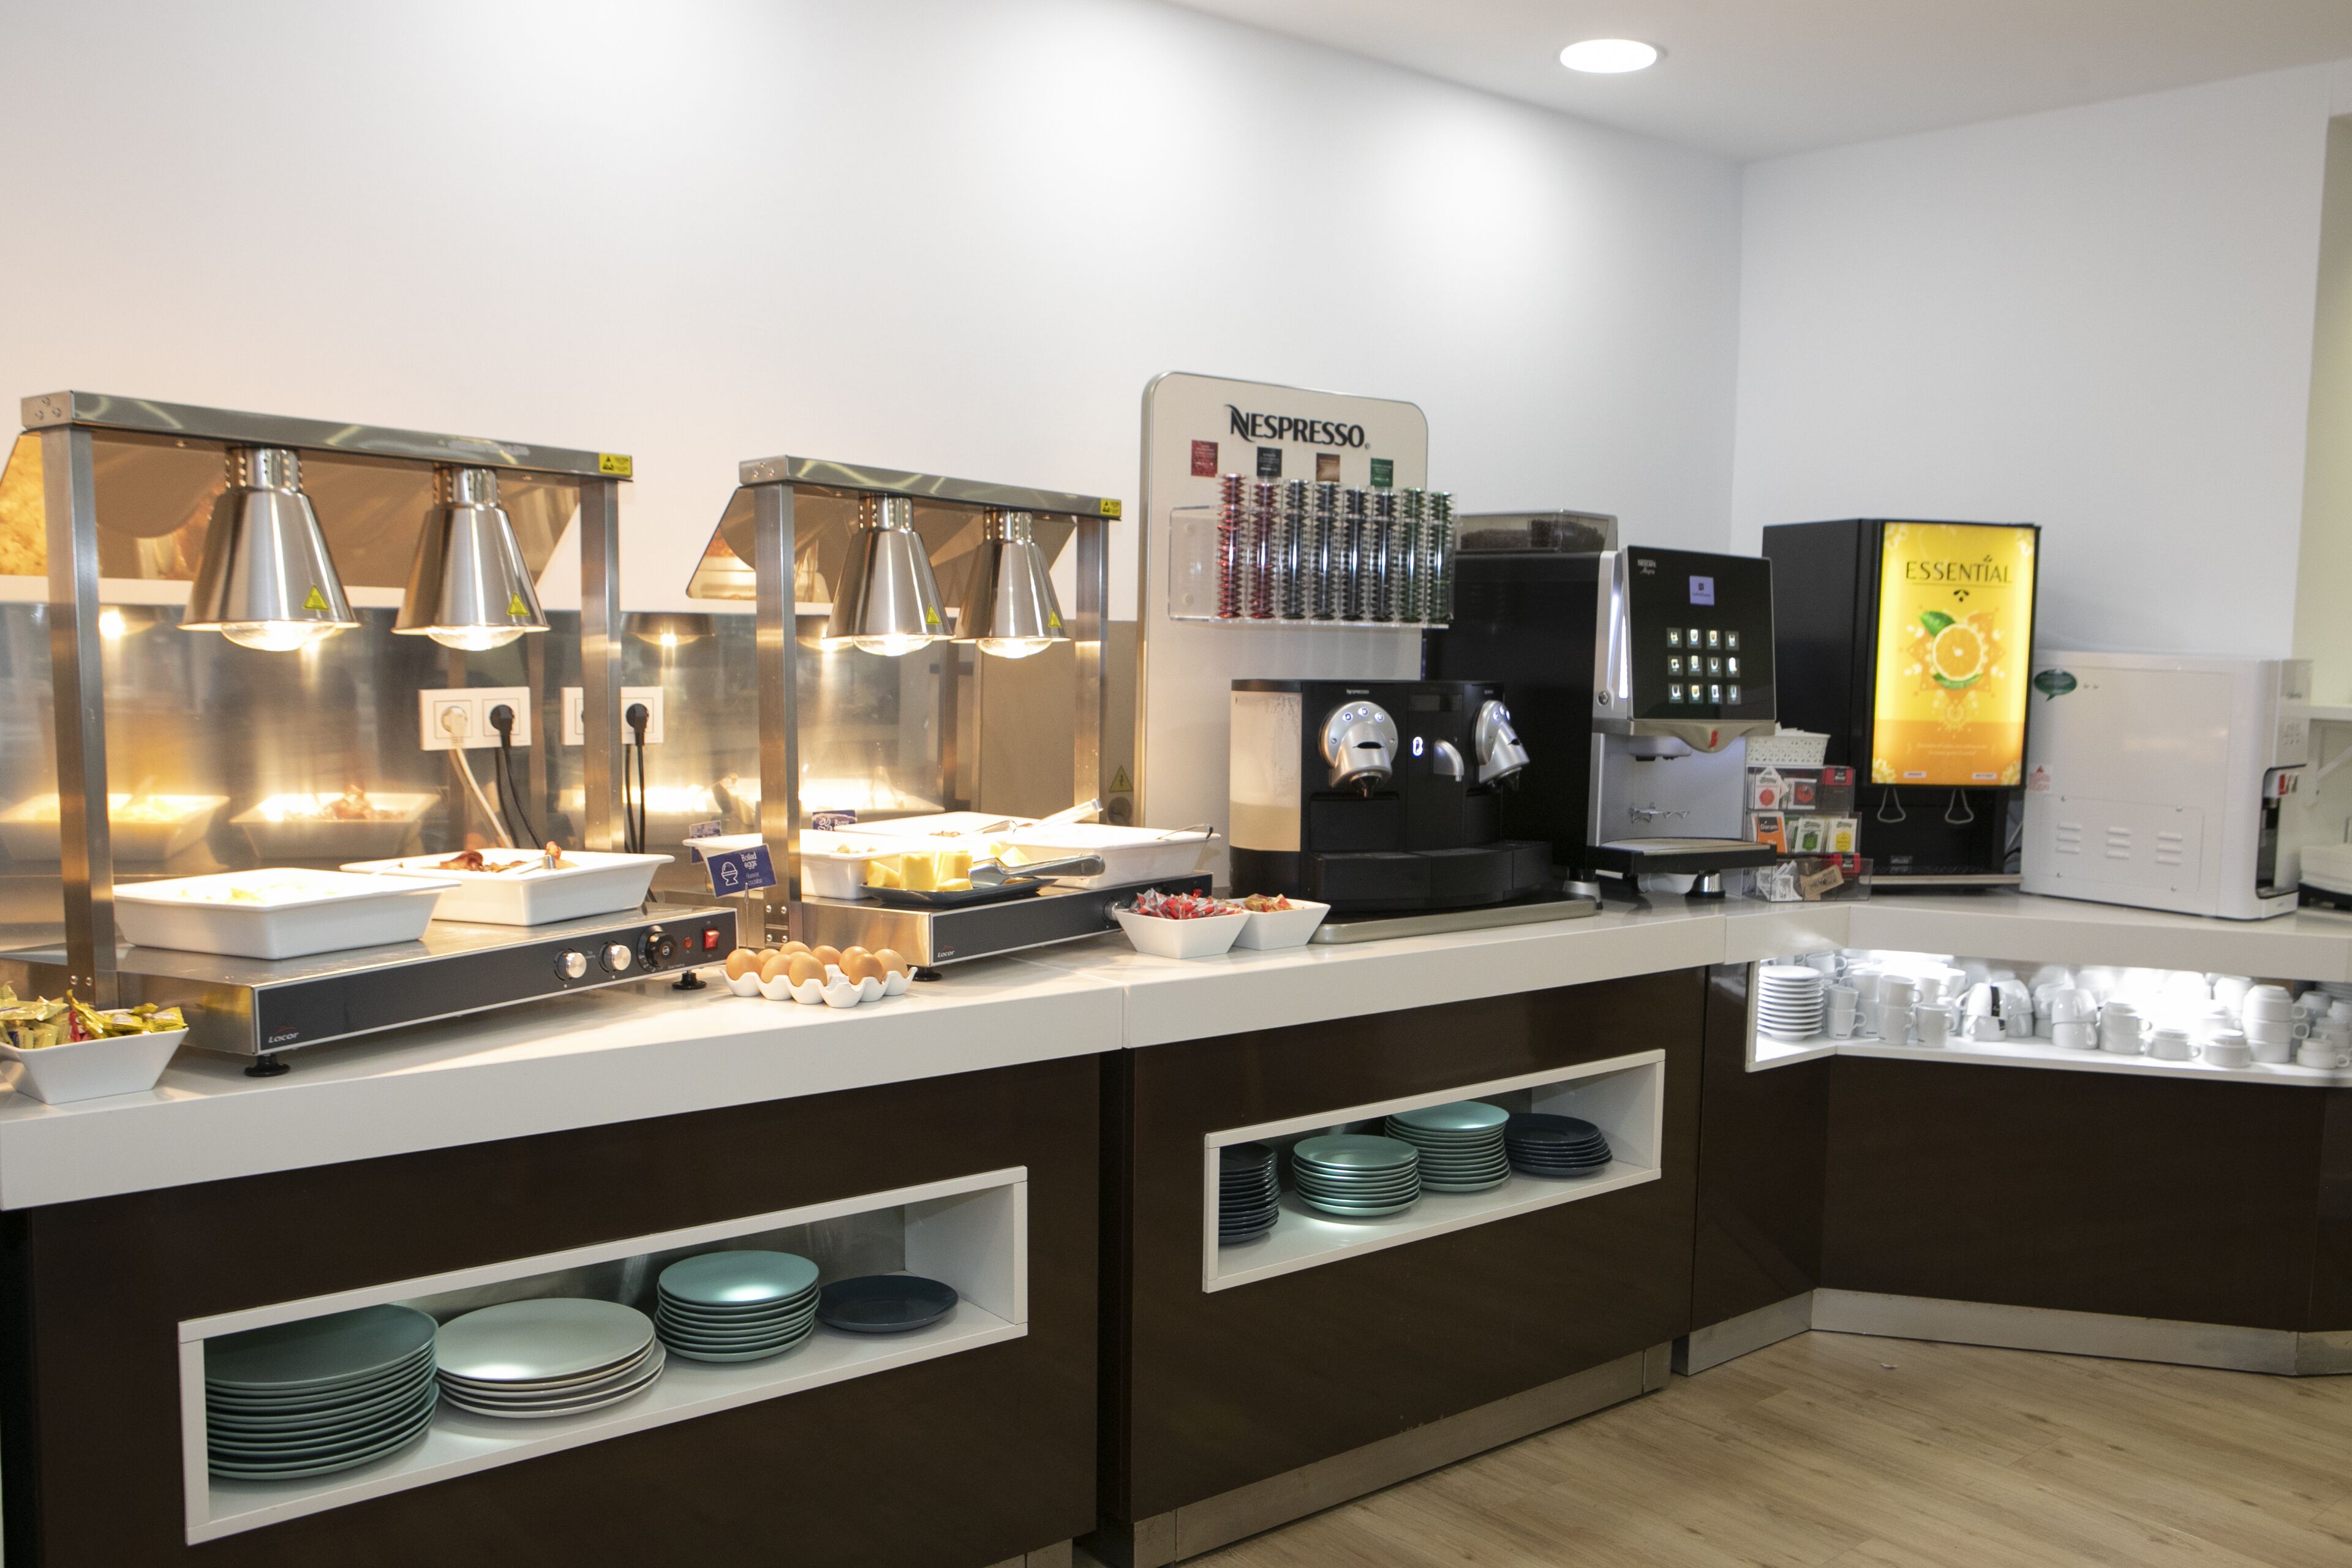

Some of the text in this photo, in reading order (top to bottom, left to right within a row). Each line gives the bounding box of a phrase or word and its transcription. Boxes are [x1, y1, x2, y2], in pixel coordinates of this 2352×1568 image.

[1224, 404, 1365, 448] NESPRESSO
[1906, 556, 2013, 584] ESSENTIAL
[741, 851, 757, 862] Boiled
[744, 860, 758, 870] eggs
